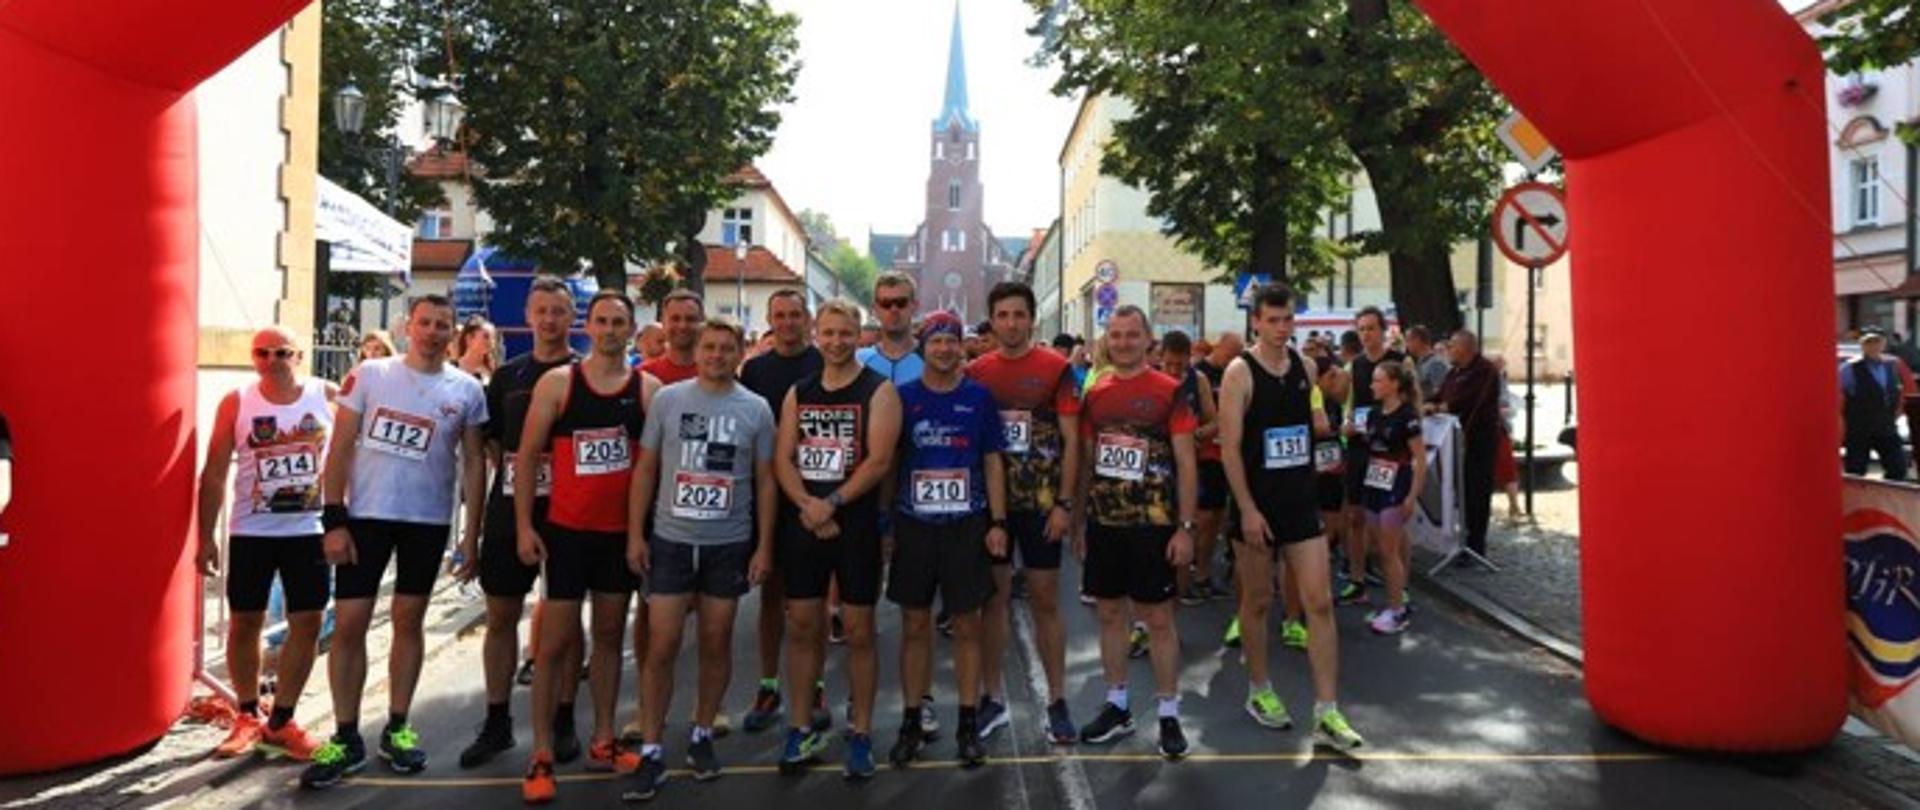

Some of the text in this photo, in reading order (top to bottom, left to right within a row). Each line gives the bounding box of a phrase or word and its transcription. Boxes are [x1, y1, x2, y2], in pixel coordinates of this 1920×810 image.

[383, 422, 422, 445] 112
[800, 422, 855, 440] THE
[585, 440, 624, 460] 205
[1275, 438, 1300, 455] 131
[265, 456, 309, 477] 214
[803, 448, 836, 467] 207
[1103, 448, 1137, 466] 200
[681, 485, 721, 505] 202
[922, 481, 960, 500] 210
